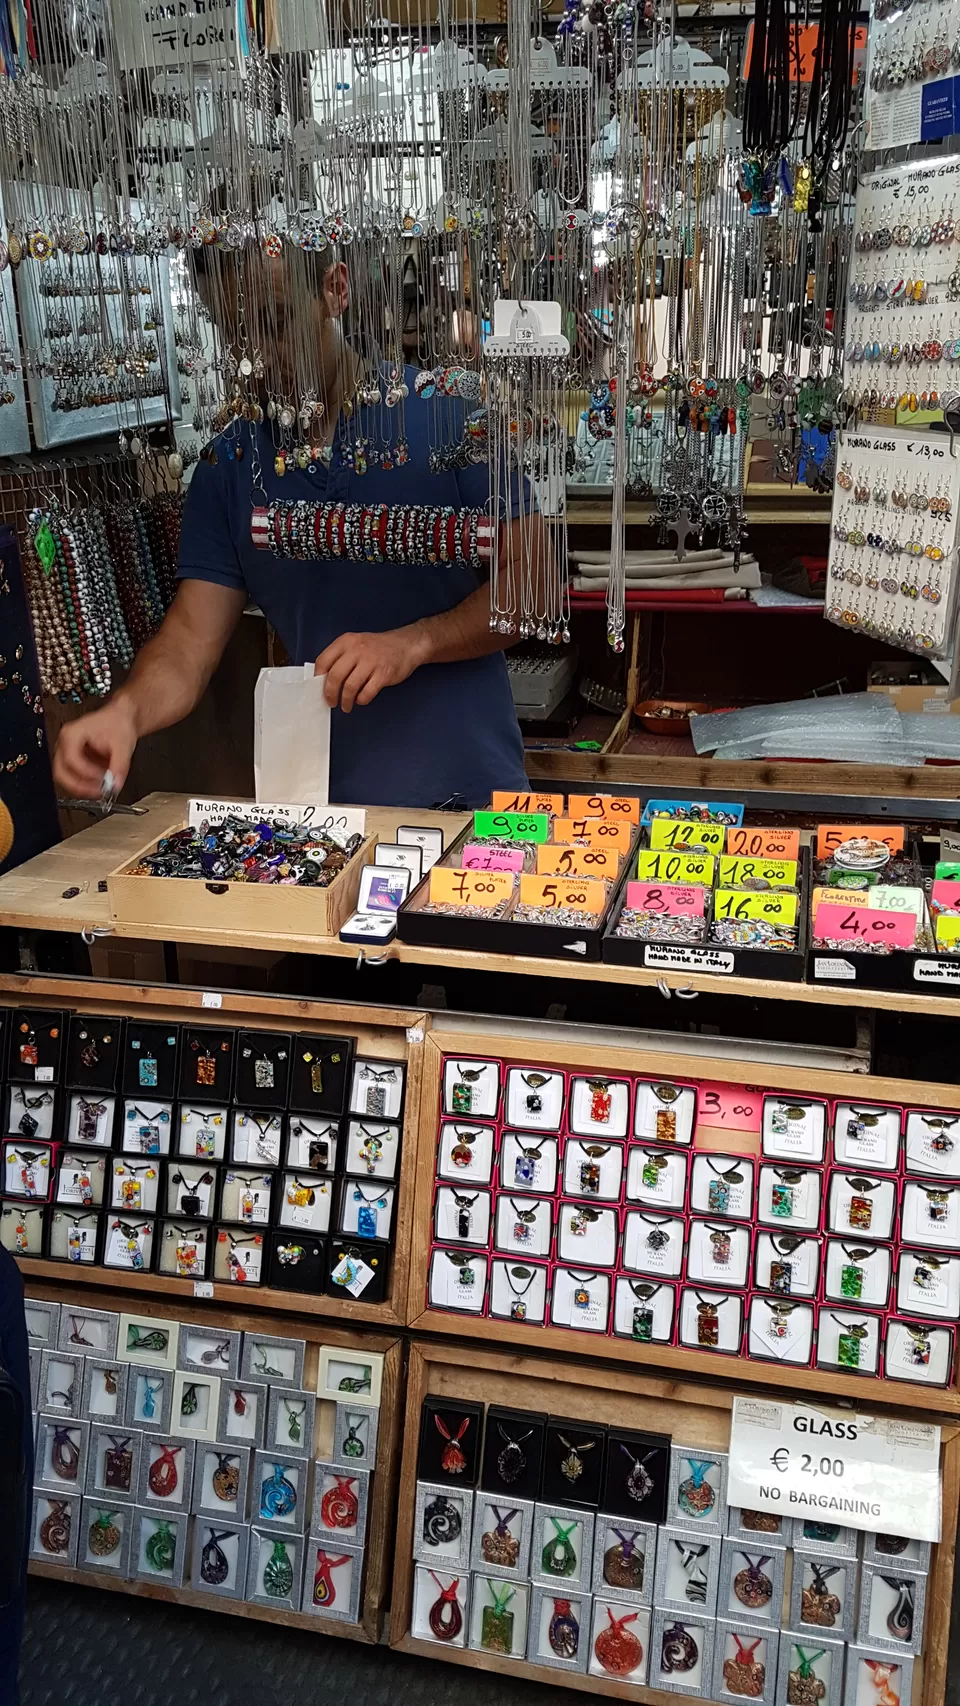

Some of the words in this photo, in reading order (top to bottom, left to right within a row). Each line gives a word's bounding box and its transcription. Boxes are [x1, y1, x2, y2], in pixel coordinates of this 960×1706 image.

[871, 176, 901, 191] ORIGINAL
[906, 169, 936, 183] MURANO
[892, 186, 904, 199] €
[904, 185, 930, 200] 15,00
[886, 300, 915, 311] STERLING
[917, 295, 939, 306] SILVER
[847, 438, 872, 449] MURANO
[873, 440, 897, 452] GLASS
[916, 445, 945, 460] 13,00
[930, 509, 953, 523] 925
[195, 802, 243, 813] MURANO
[250, 805, 290, 817] GLASS
[488, 816, 538, 839] 9,00
[489, 849, 513, 858] STEEL
[452, 872, 496, 902] 7,00
[542, 885, 587, 908] 5,00
[642, 889, 695, 912] 8,00
[840, 911, 896, 936] 4,00
[650, 945, 686, 955] MURANO
[690, 949, 720, 958] GLASS
[648, 953, 669, 961] HAND
[671, 955, 692, 964] MADE
[705, 959, 731, 970] ITALY
[919, 969, 944, 977] HAND
[699, 1092, 754, 1120] 3,00
[784, 1138, 803, 1146] ITALIA
[857, 1146, 876, 1154] ITALIA
[920, 1150, 938, 1161] ITALIA
[793, 1416, 858, 1441] GLASS
[769, 1447, 790, 1473] €
[800, 1453, 845, 1478] 2,00
[759, 1485, 781, 1500] NO
[788, 1490, 881, 1517] BARGAINING
